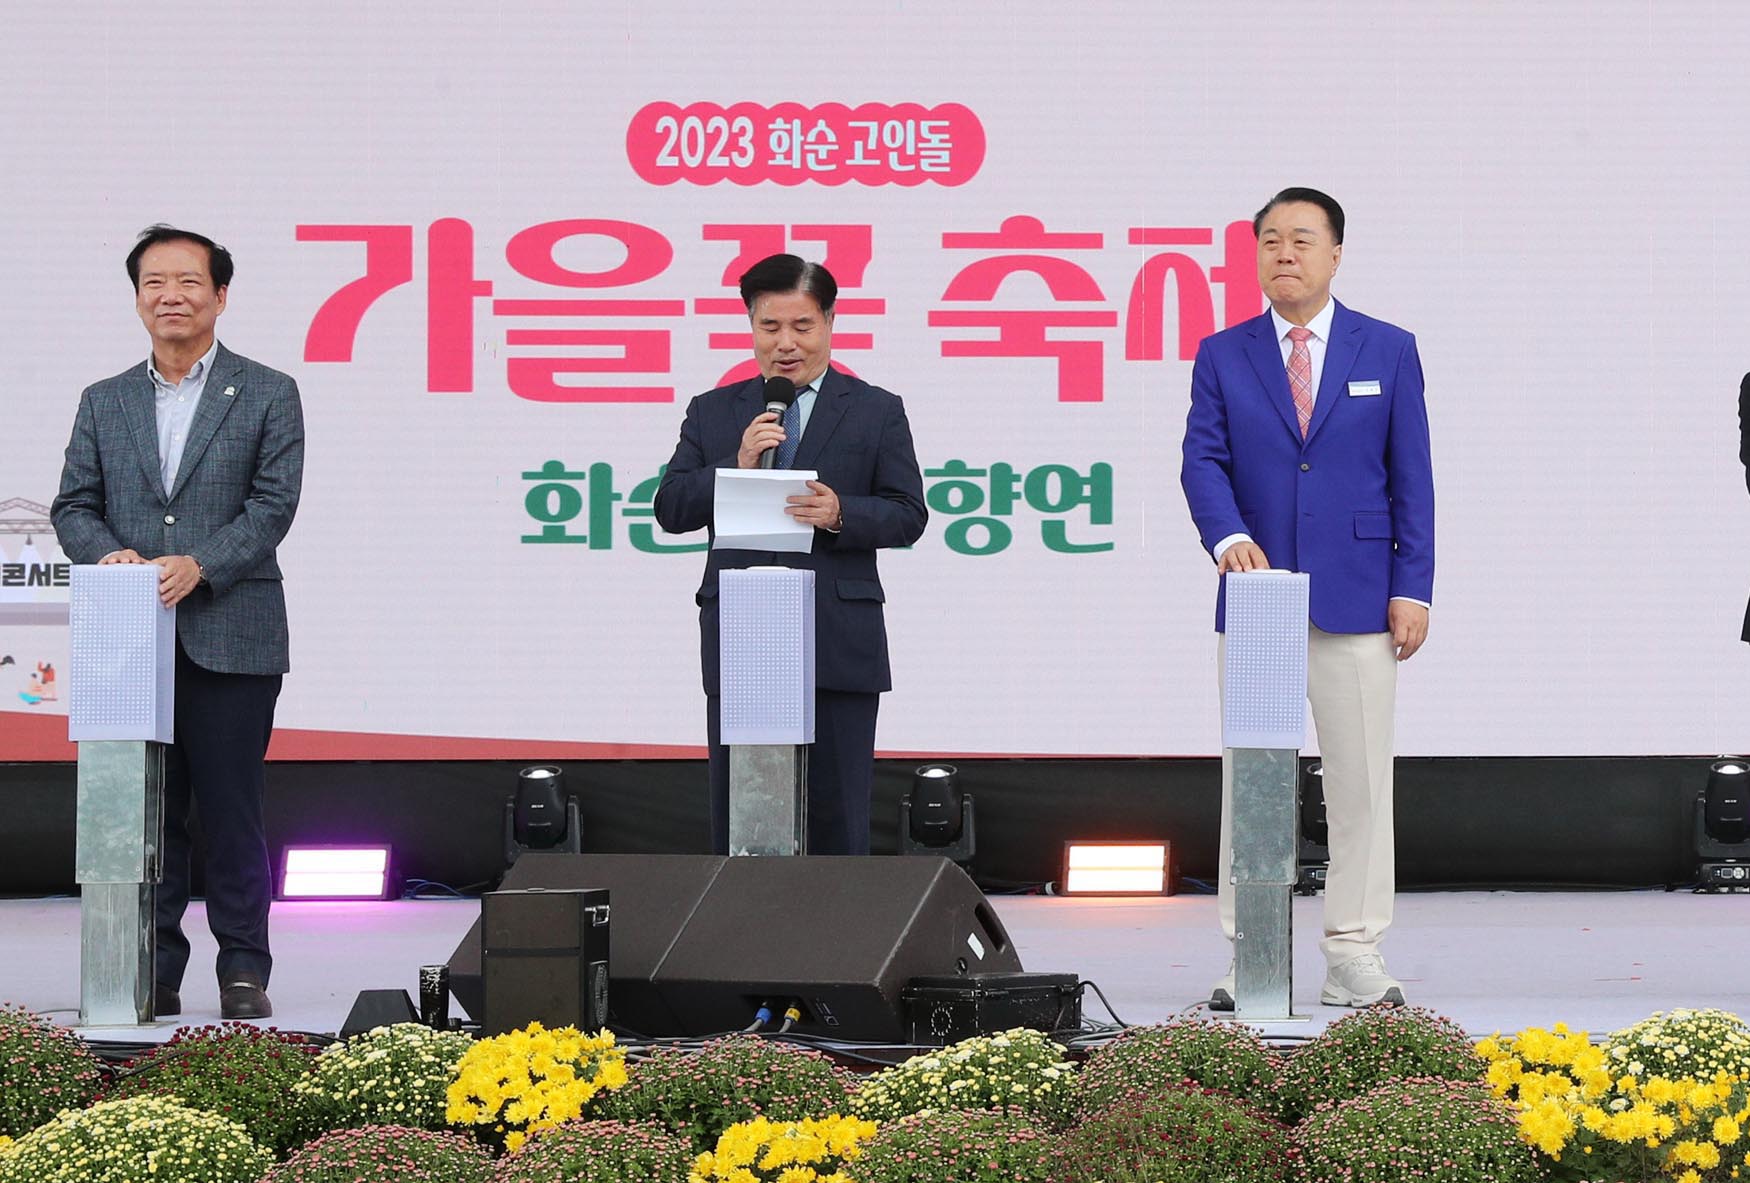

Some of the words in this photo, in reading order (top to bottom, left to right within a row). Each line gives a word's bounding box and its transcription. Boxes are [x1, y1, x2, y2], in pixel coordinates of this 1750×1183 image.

[655, 116, 756, 168] 2023
[768, 117, 840, 171] 화순
[846, 119, 953, 172] 고인돌
[924, 459, 1114, 555] 향연
[2, 563, 70, 586] 콘서트
